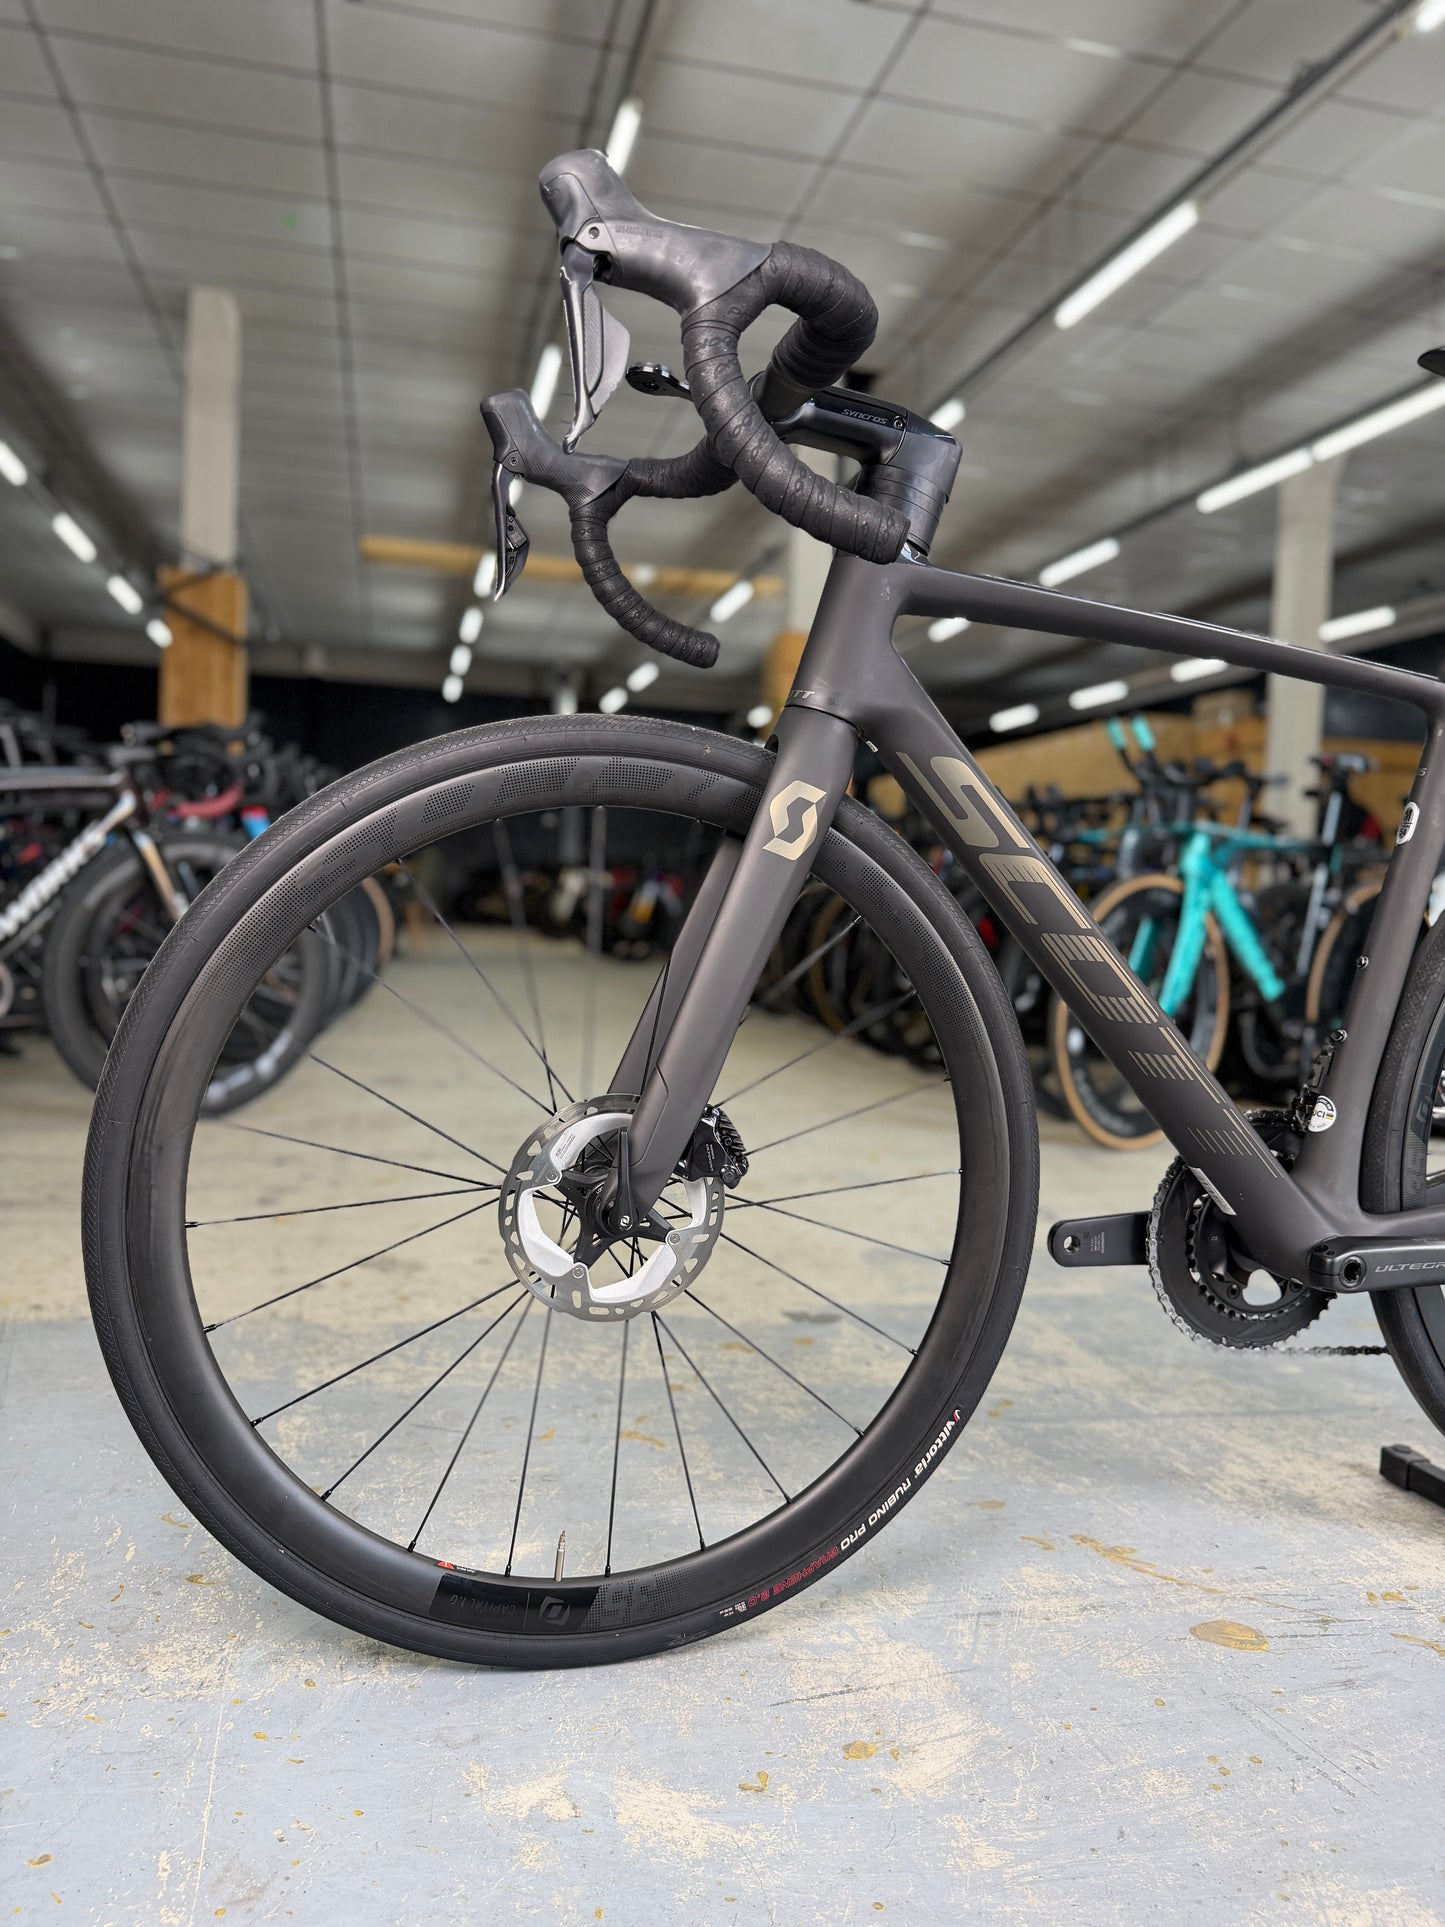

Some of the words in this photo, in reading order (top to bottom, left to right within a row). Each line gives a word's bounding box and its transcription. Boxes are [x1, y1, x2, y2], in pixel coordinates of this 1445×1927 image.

[896, 751, 1283, 1179] SCOTT
[1374, 1261, 1445, 1273] ULTEGR
[867, 1477, 912, 1526] RUBINO
[839, 1522, 867, 1550] PRO
[772, 1545, 839, 1596] GRAPHENE
[470, 1598, 516, 1618] CAPITAL
[746, 1589, 770, 1608] 2.0
